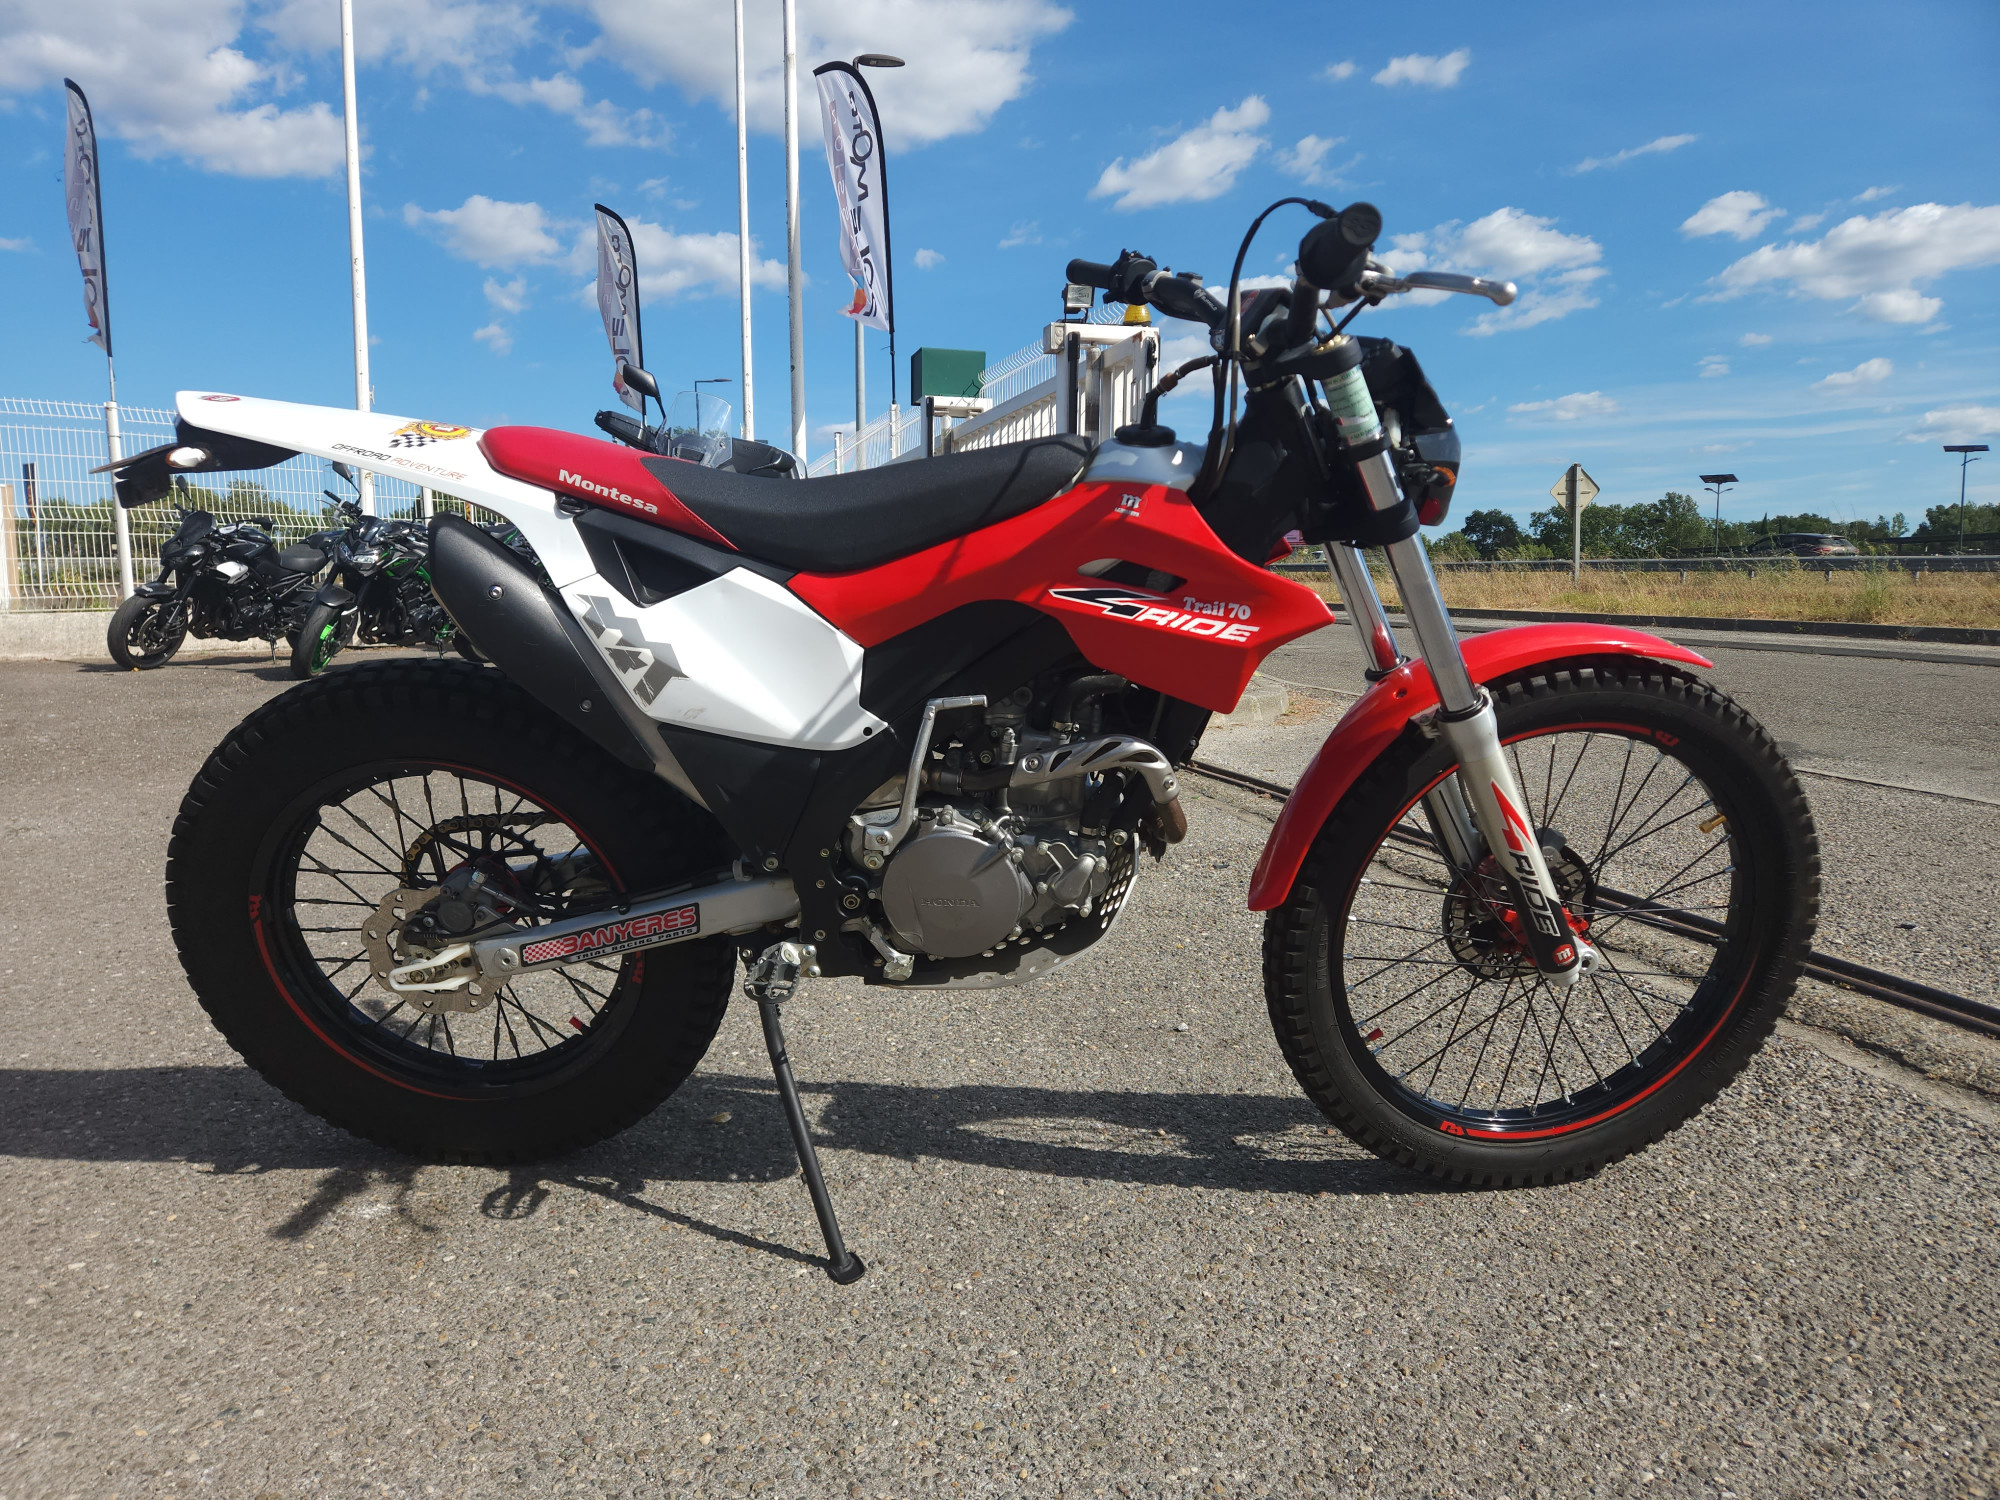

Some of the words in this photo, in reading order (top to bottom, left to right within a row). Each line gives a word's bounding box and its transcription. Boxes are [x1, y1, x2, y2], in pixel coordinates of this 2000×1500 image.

[331, 443, 392, 461] OFFROAD
[391, 457, 468, 480] ADVENTURE
[558, 469, 658, 515] Montesa
[1183, 596, 1224, 617] Trail
[1228, 602, 1251, 620] 70
[563, 907, 697, 955] BANYERES
[575, 948, 606, 961] TRIAL
[611, 937, 653, 951] RACING
[658, 928, 693, 941] PARTS
